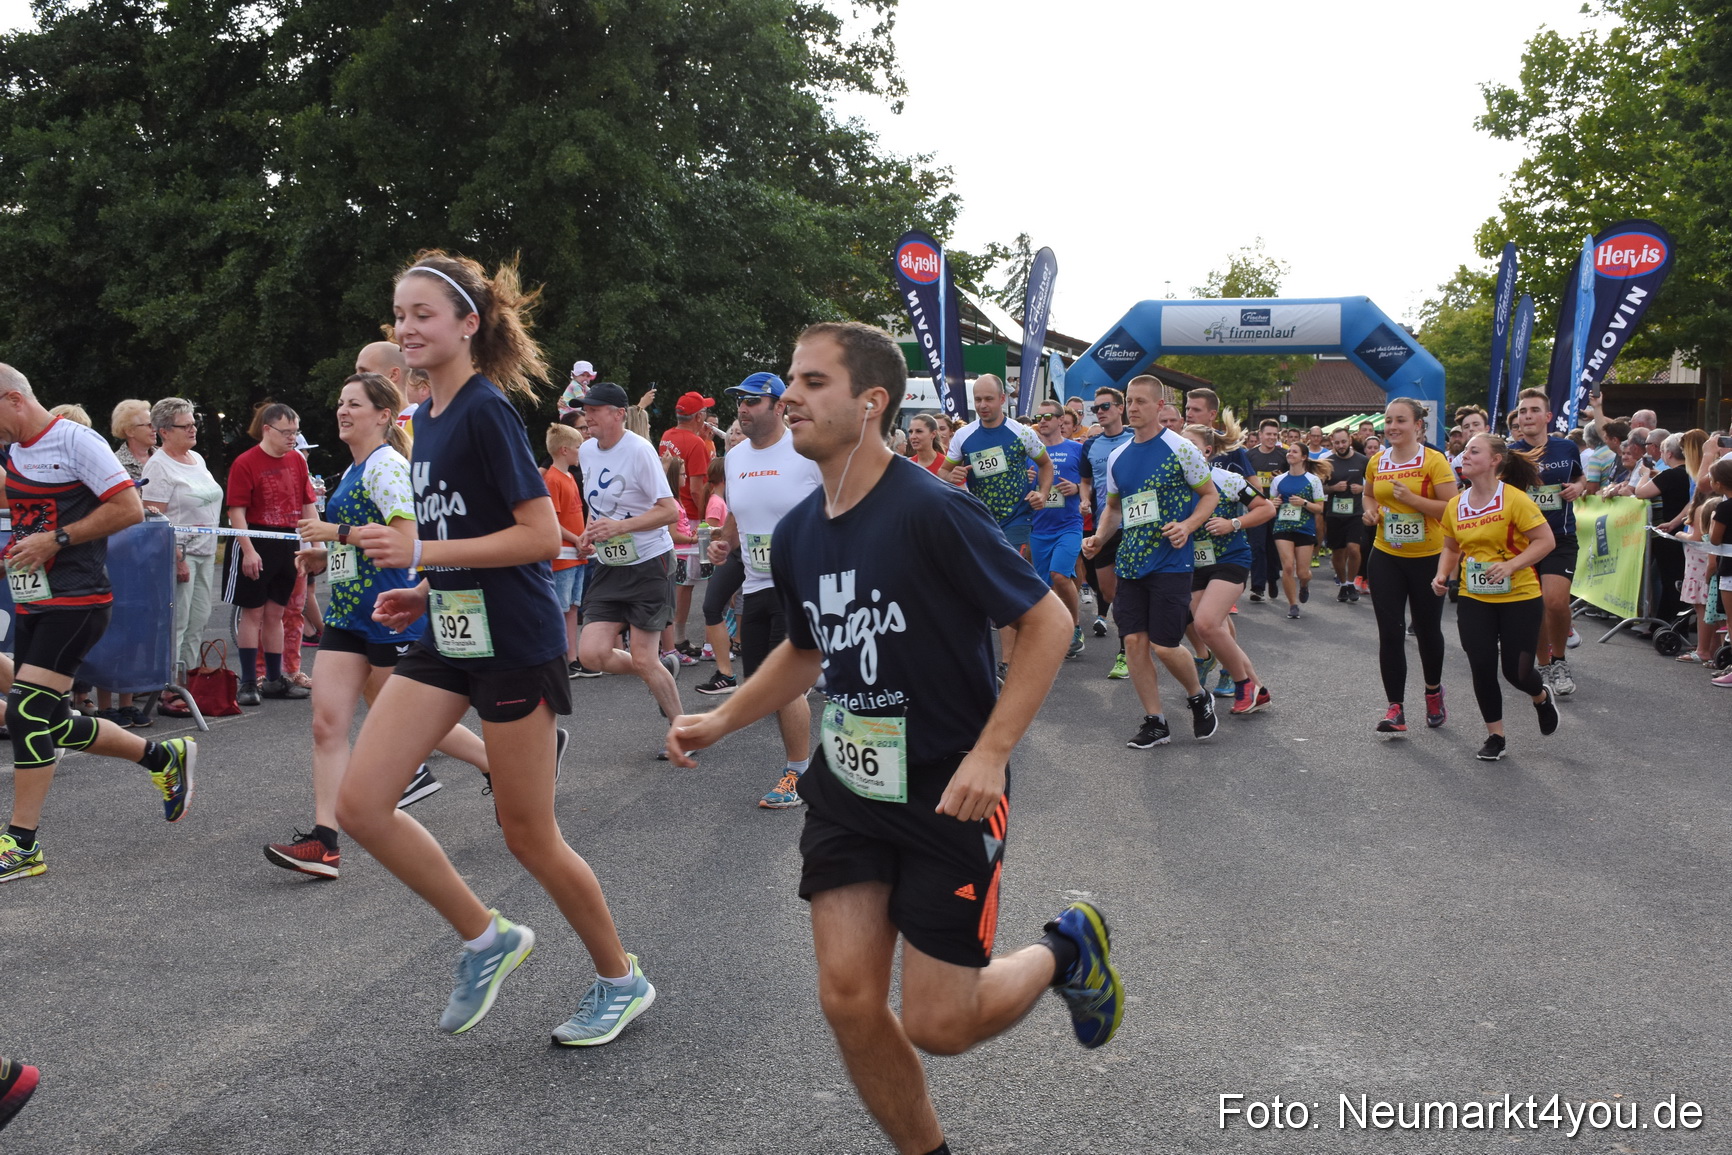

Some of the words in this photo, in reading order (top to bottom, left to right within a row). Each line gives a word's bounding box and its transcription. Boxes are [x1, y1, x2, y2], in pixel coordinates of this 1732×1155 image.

[1597, 244, 1660, 268] Hervis
[1229, 326, 1297, 339] firmenlauf
[1104, 347, 1140, 357] Fischer
[978, 457, 998, 471] 250
[1545, 460, 1569, 469] POLES
[1375, 473, 1395, 482] MAX
[1398, 470, 1424, 479] BÖGL
[1046, 493, 1058, 502] 22
[1532, 494, 1554, 504] 704
[1128, 502, 1148, 518] 217
[1388, 523, 1420, 535] 1583
[1457, 522, 1478, 531] MAX
[1480, 514, 1505, 526] BÖGL
[604, 544, 628, 558] 678
[1193, 550, 1207, 560] 08
[330, 552, 347, 571] 267
[439, 614, 472, 639] 392
[834, 736, 880, 777] 396
